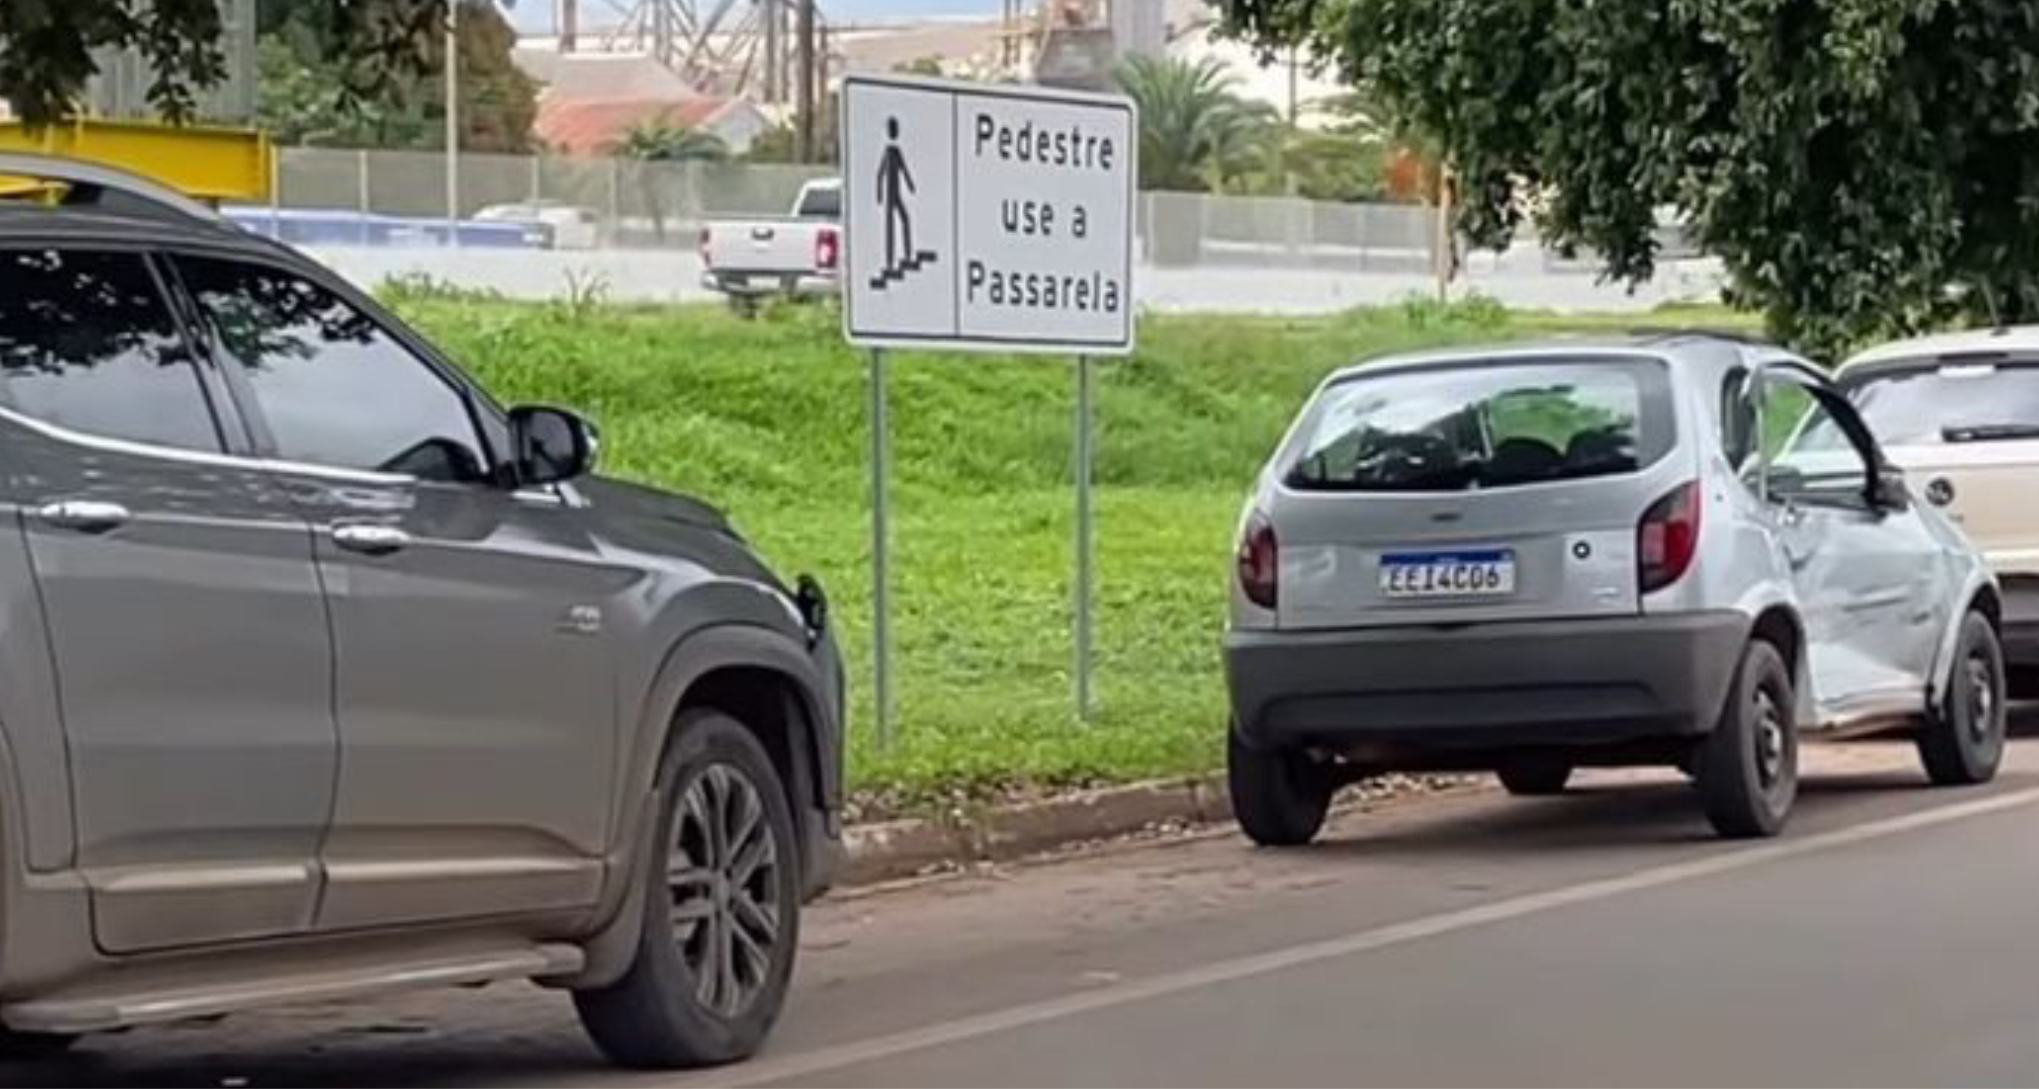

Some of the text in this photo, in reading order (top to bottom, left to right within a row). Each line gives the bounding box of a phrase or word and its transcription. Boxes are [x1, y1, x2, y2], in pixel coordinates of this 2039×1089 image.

[974, 113, 1114, 170] Pedestre
[1001, 199, 1087, 239] use a
[967, 260, 1119, 313] Passarela
